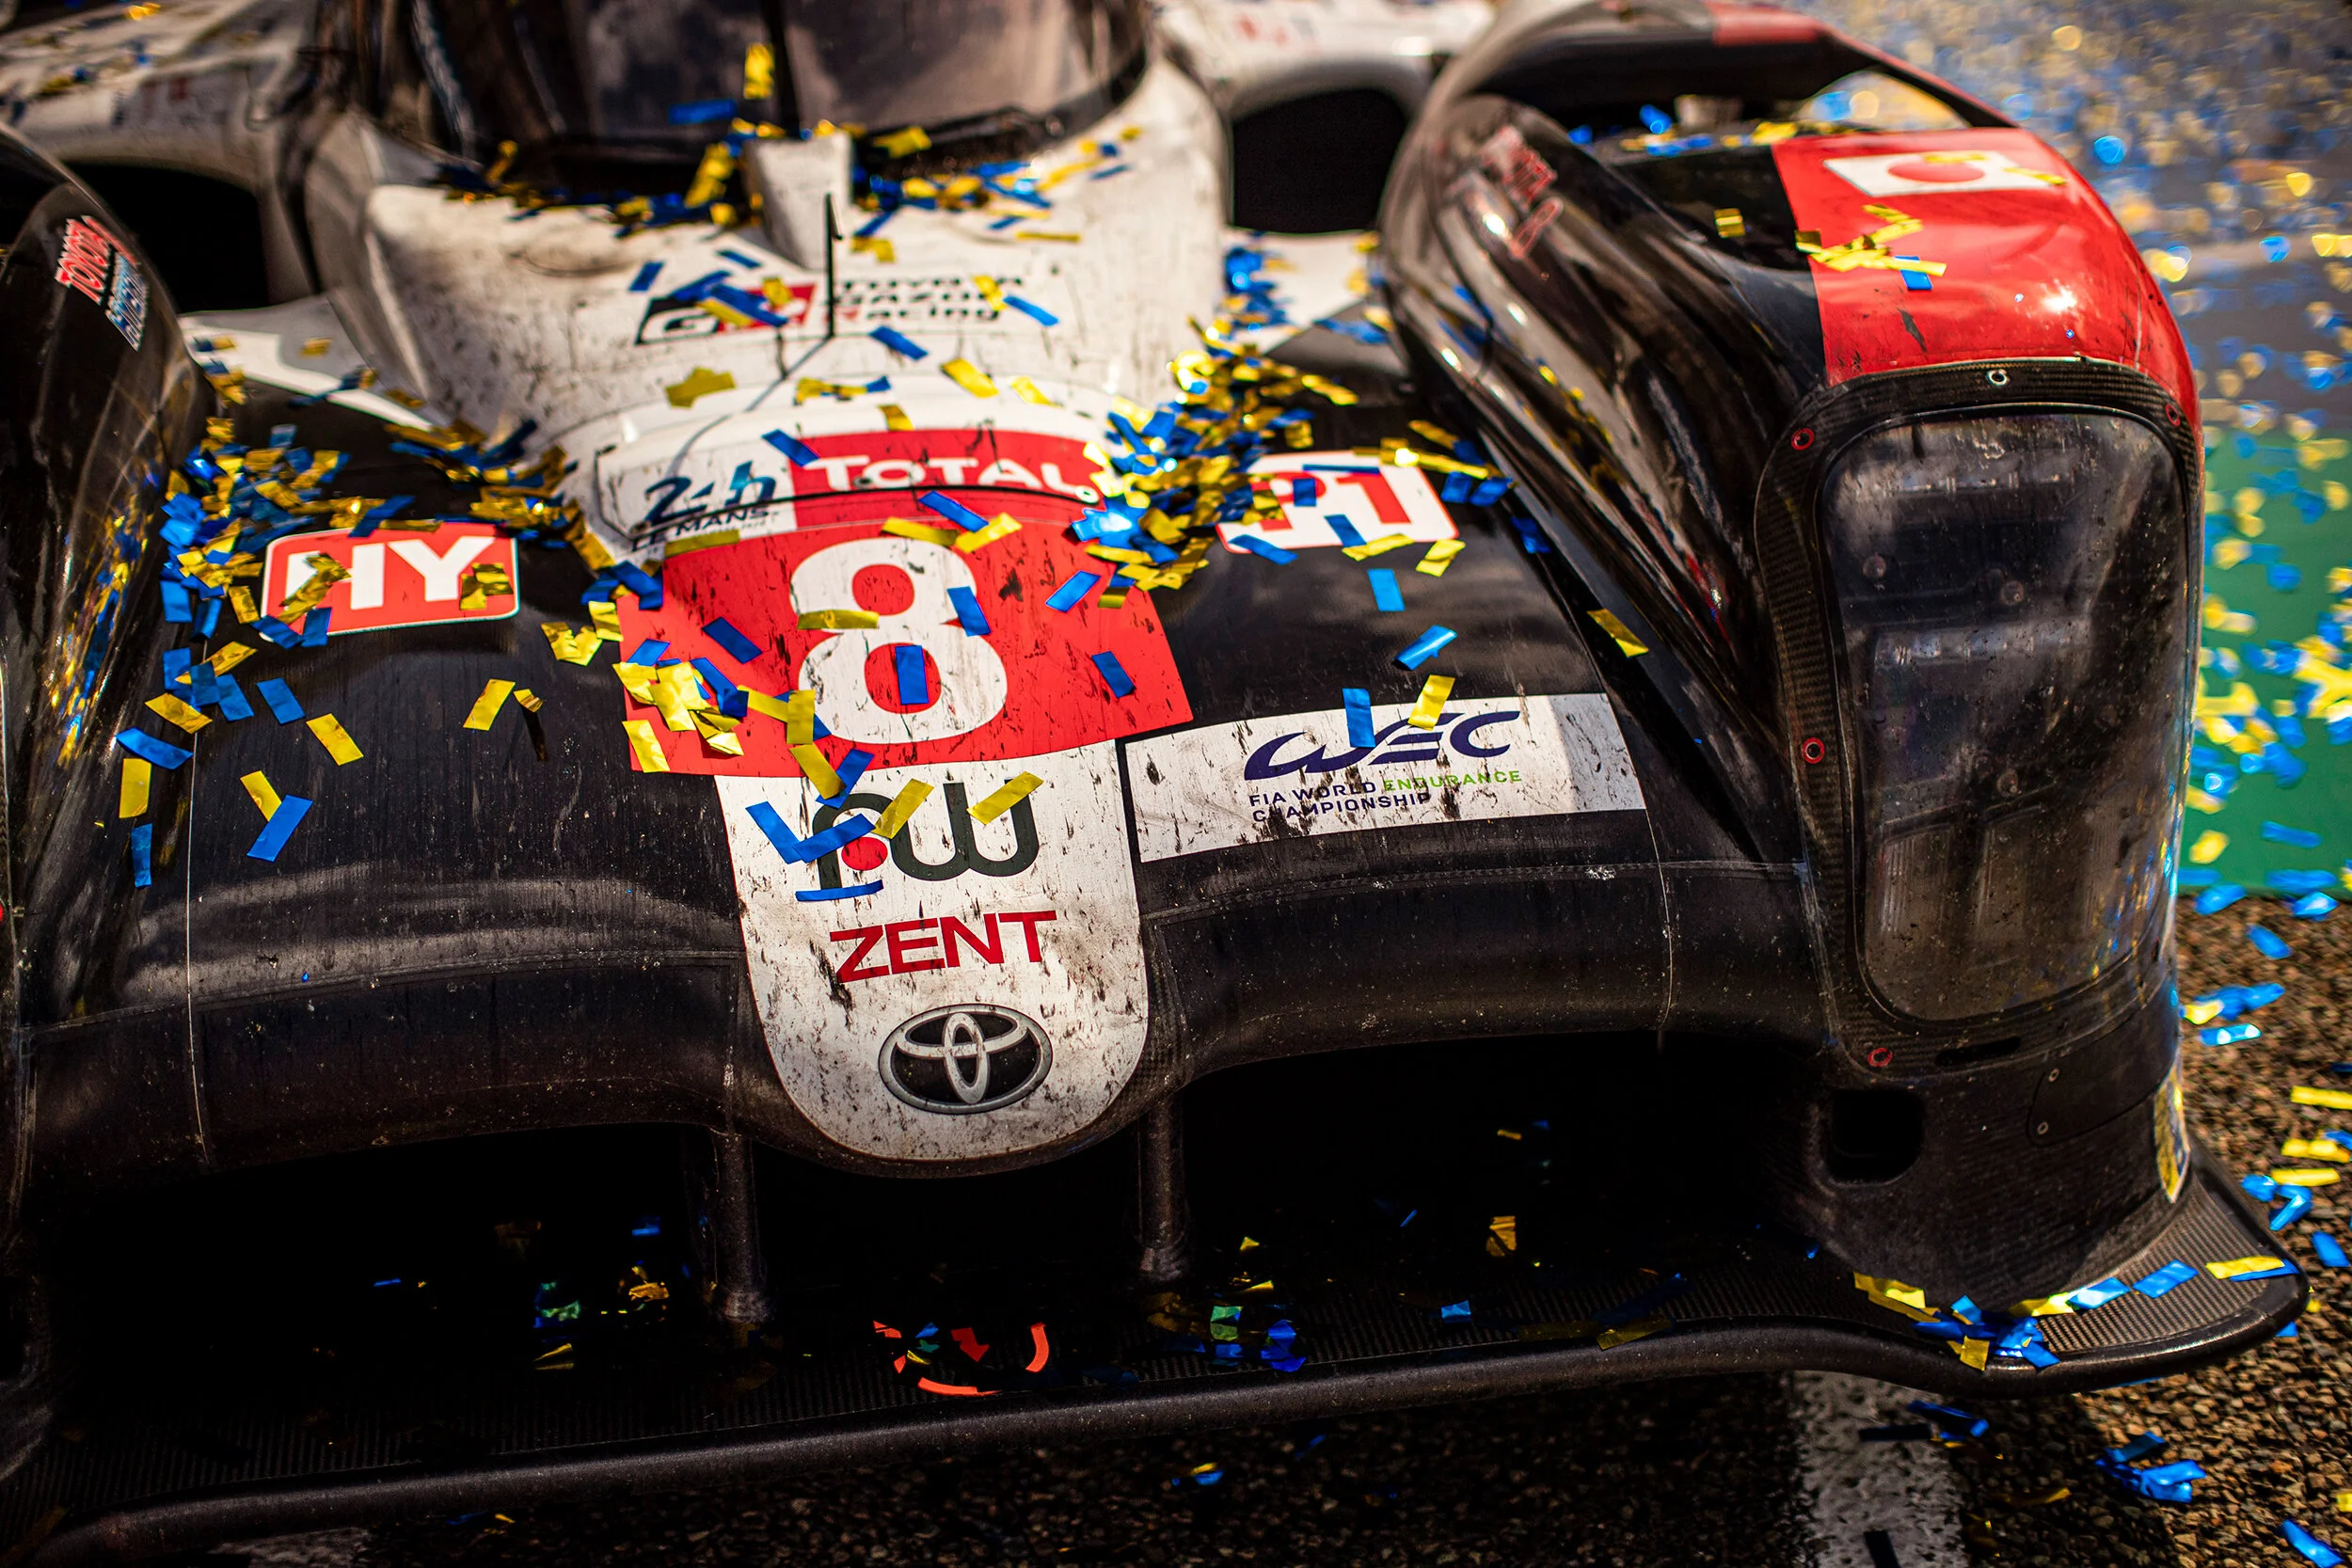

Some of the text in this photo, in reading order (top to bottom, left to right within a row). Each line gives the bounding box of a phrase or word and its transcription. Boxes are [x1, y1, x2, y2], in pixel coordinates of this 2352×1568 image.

[803, 453, 1093, 499] TOTAL
[675, 504, 771, 537] MANS
[789, 537, 1008, 744] 8
[1244, 710, 1520, 781] WEC
[1249, 770, 1522, 807] FIA WORLD ENDURANCE
[1252, 793, 1431, 822] CAMPIONSHIP
[830, 910, 1057, 984] ZENT
